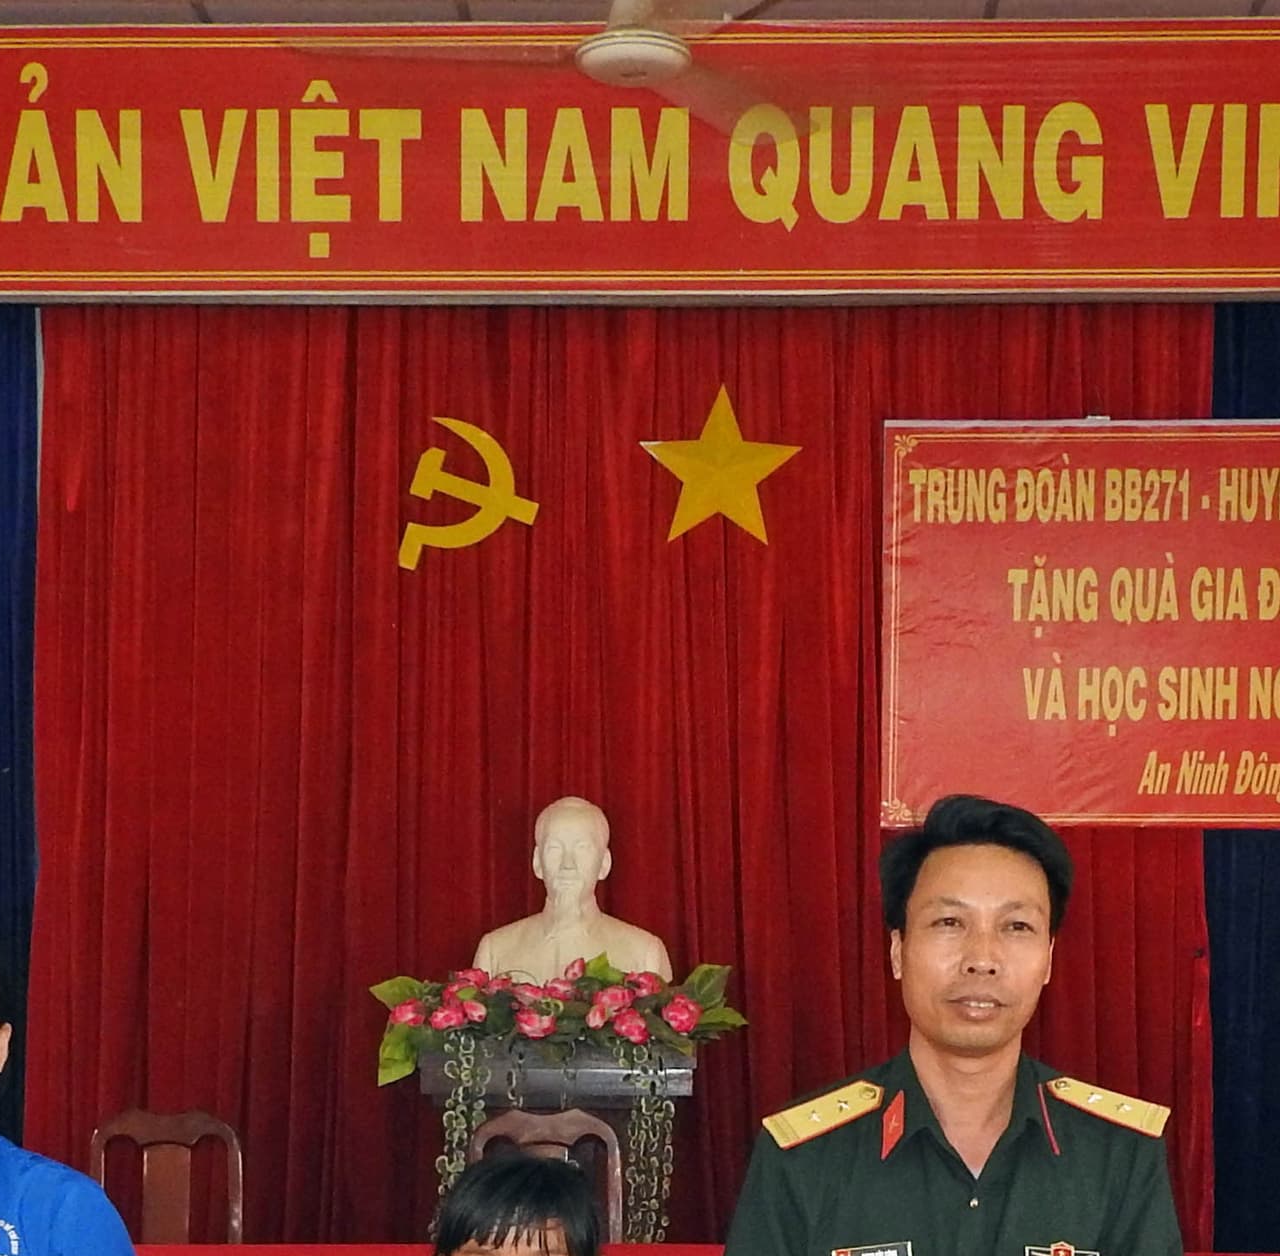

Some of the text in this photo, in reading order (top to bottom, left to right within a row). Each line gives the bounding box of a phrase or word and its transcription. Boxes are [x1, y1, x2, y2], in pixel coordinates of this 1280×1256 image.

[180, 80, 421, 258] VIỆT
[461, 107, 689, 222] NAM
[728, 102, 1103, 232] QUANG
[908, 468, 1006, 524] TRUNG
[1015, 453, 1095, 524] ĐOÀN
[1105, 469, 1189, 522] BB271
[1008, 556, 1098, 638] TẶNG
[1110, 552, 1179, 625] QUÀ
[1191, 567, 1248, 621] GIA
[1023, 652, 1066, 720] VÀ
[1078, 666, 1147, 736] HỌC
[1158, 666, 1238, 721] SINH
[1138, 751, 1171, 794] An
[1176, 751, 1229, 794] Ninh
